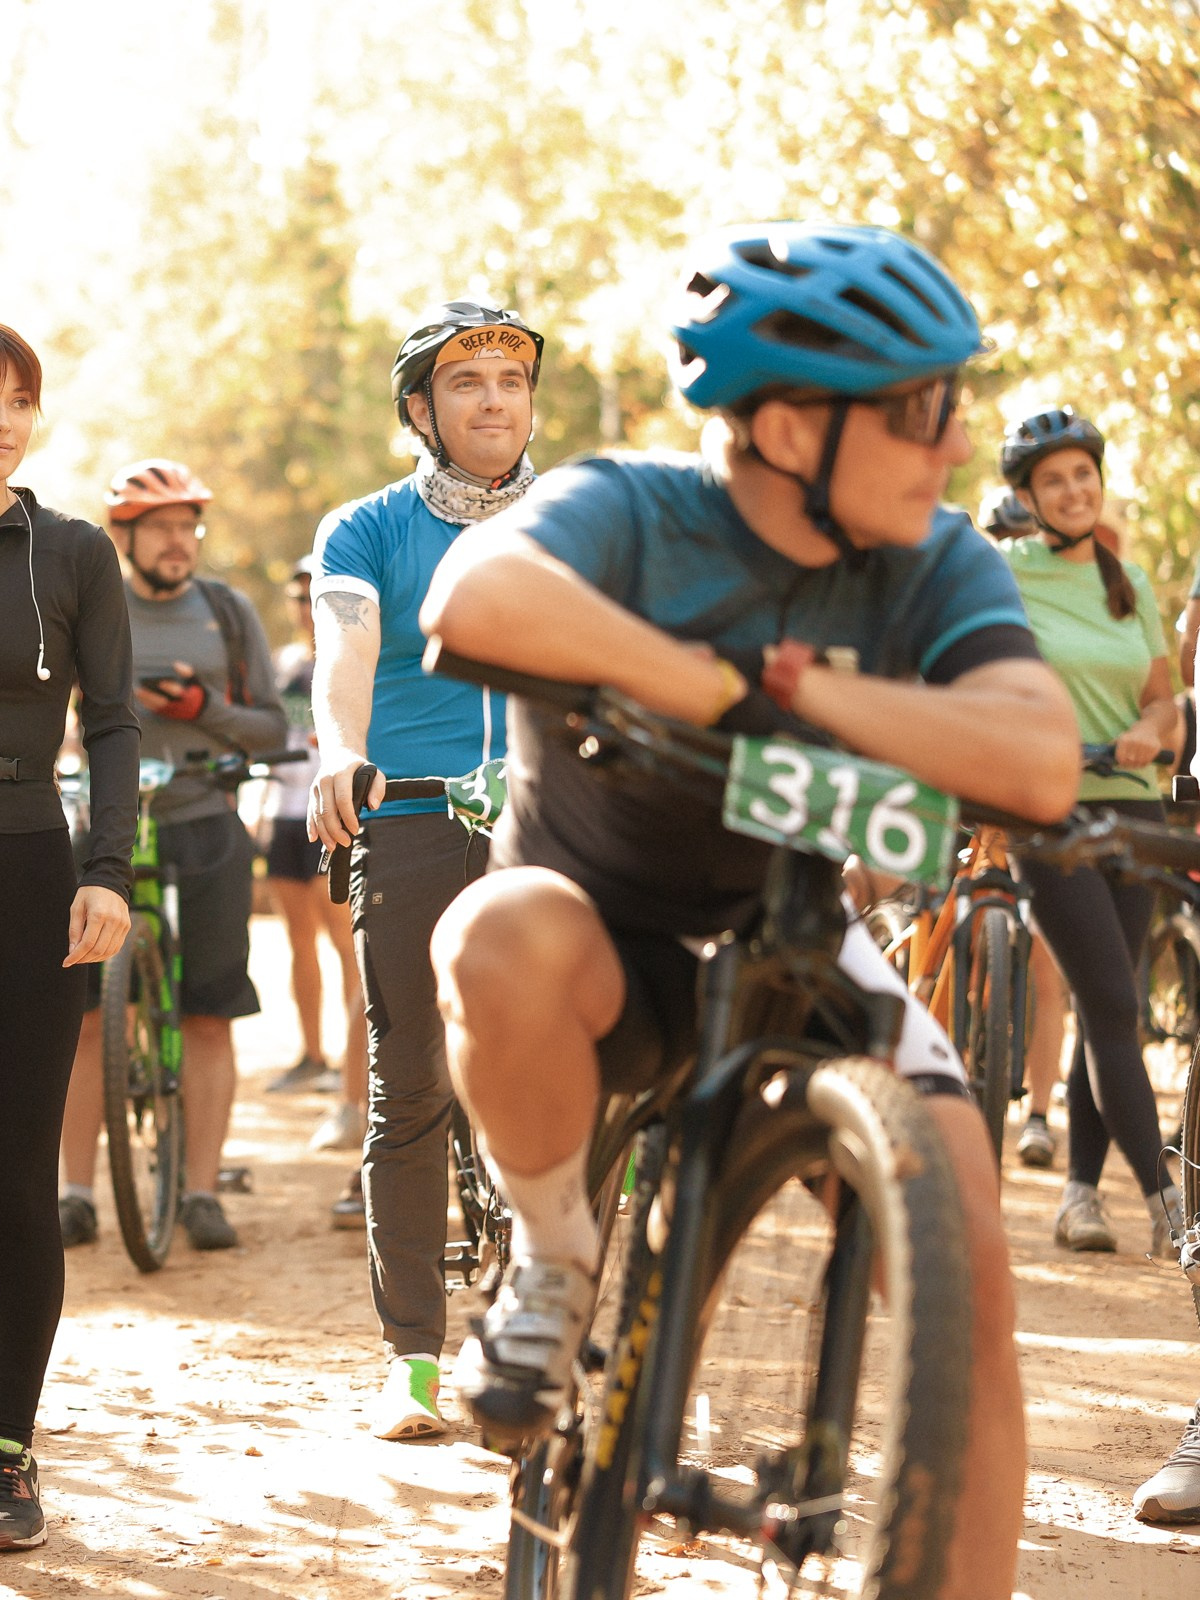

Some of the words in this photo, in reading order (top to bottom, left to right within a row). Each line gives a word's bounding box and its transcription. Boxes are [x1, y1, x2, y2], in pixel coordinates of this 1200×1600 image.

[458, 330, 496, 351] BEER
[498, 331, 527, 353] RIDE
[750, 744, 927, 873] 316
